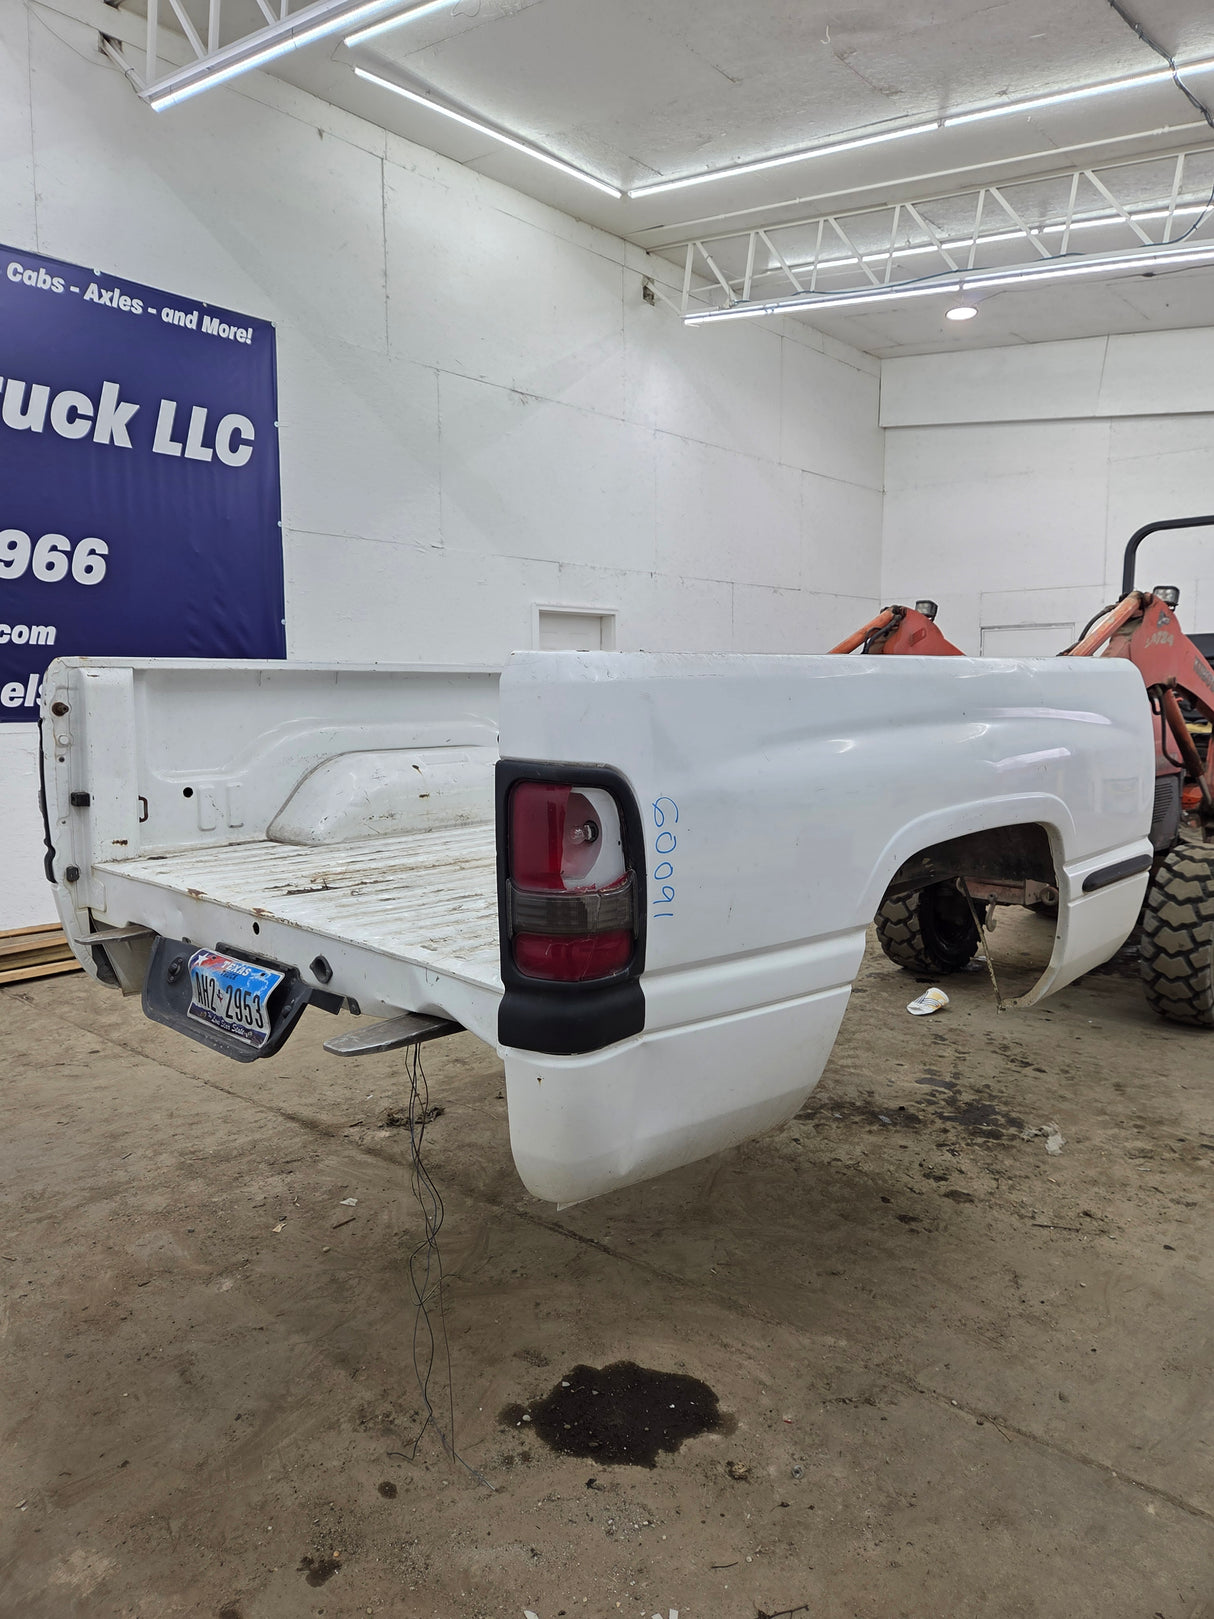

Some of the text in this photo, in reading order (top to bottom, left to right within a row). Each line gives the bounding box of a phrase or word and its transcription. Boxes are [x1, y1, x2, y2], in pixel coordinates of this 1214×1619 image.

[7, 262, 65, 294] Cabs
[84, 282, 144, 316] Axles
[161, 307, 199, 330] and
[201, 315, 254, 345] More!
[0, 376, 256, 468] uck LLC
[1, 673, 43, 707] el
[221, 960, 252, 977] TEXAS
[195, 971, 264, 1029] AH2 2953
